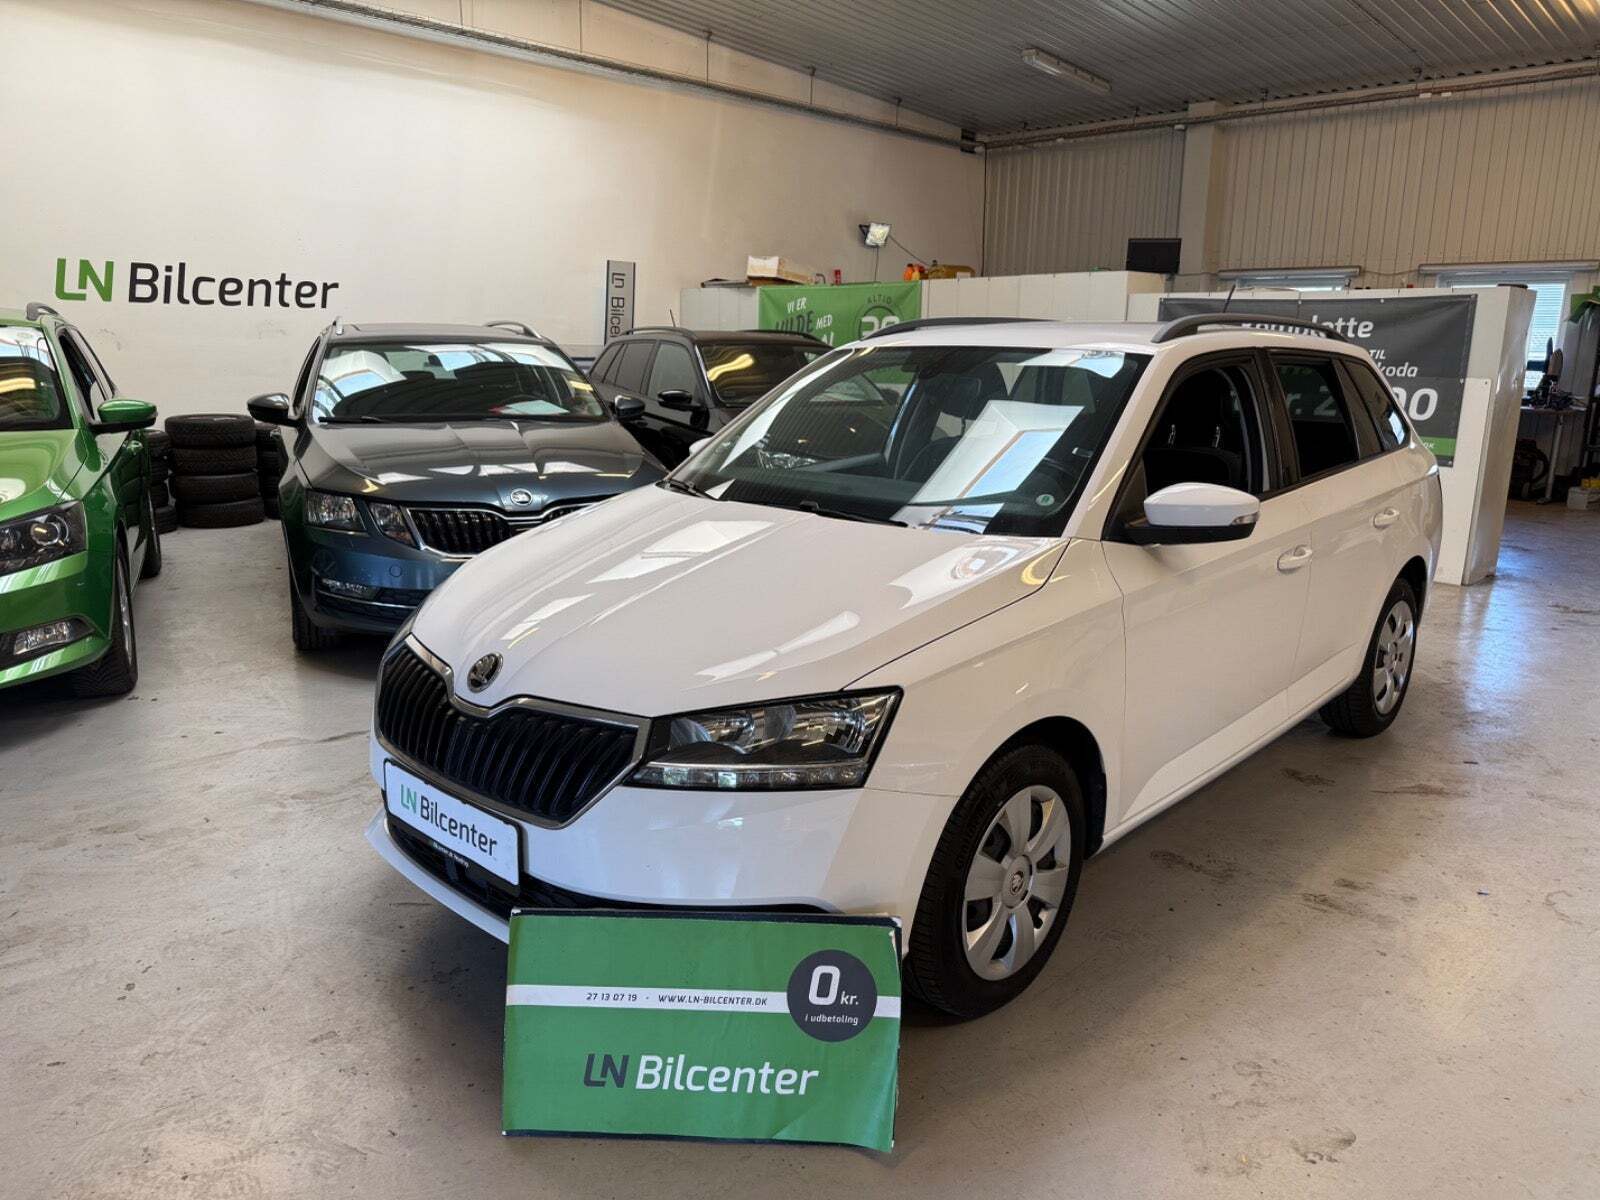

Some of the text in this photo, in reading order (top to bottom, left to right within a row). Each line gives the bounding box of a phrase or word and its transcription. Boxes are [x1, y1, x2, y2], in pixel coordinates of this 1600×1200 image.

[54, 258, 340, 309] LN Bilcenter
[609, 296, 625, 338] Bilce
[816, 314, 833, 330] MED
[1374, 362, 1419, 378] koda
[400, 783, 418, 814] LN
[420, 795, 498, 857] Bilcenter
[586, 992, 768, 1006] 27 13 07 19 WWW.LN-BILCENTER.DK
[808, 965, 860, 1006] 0 kr.
[810, 1013, 859, 1026] udbetaling
[583, 1053, 820, 1096] LN Bilcenter
